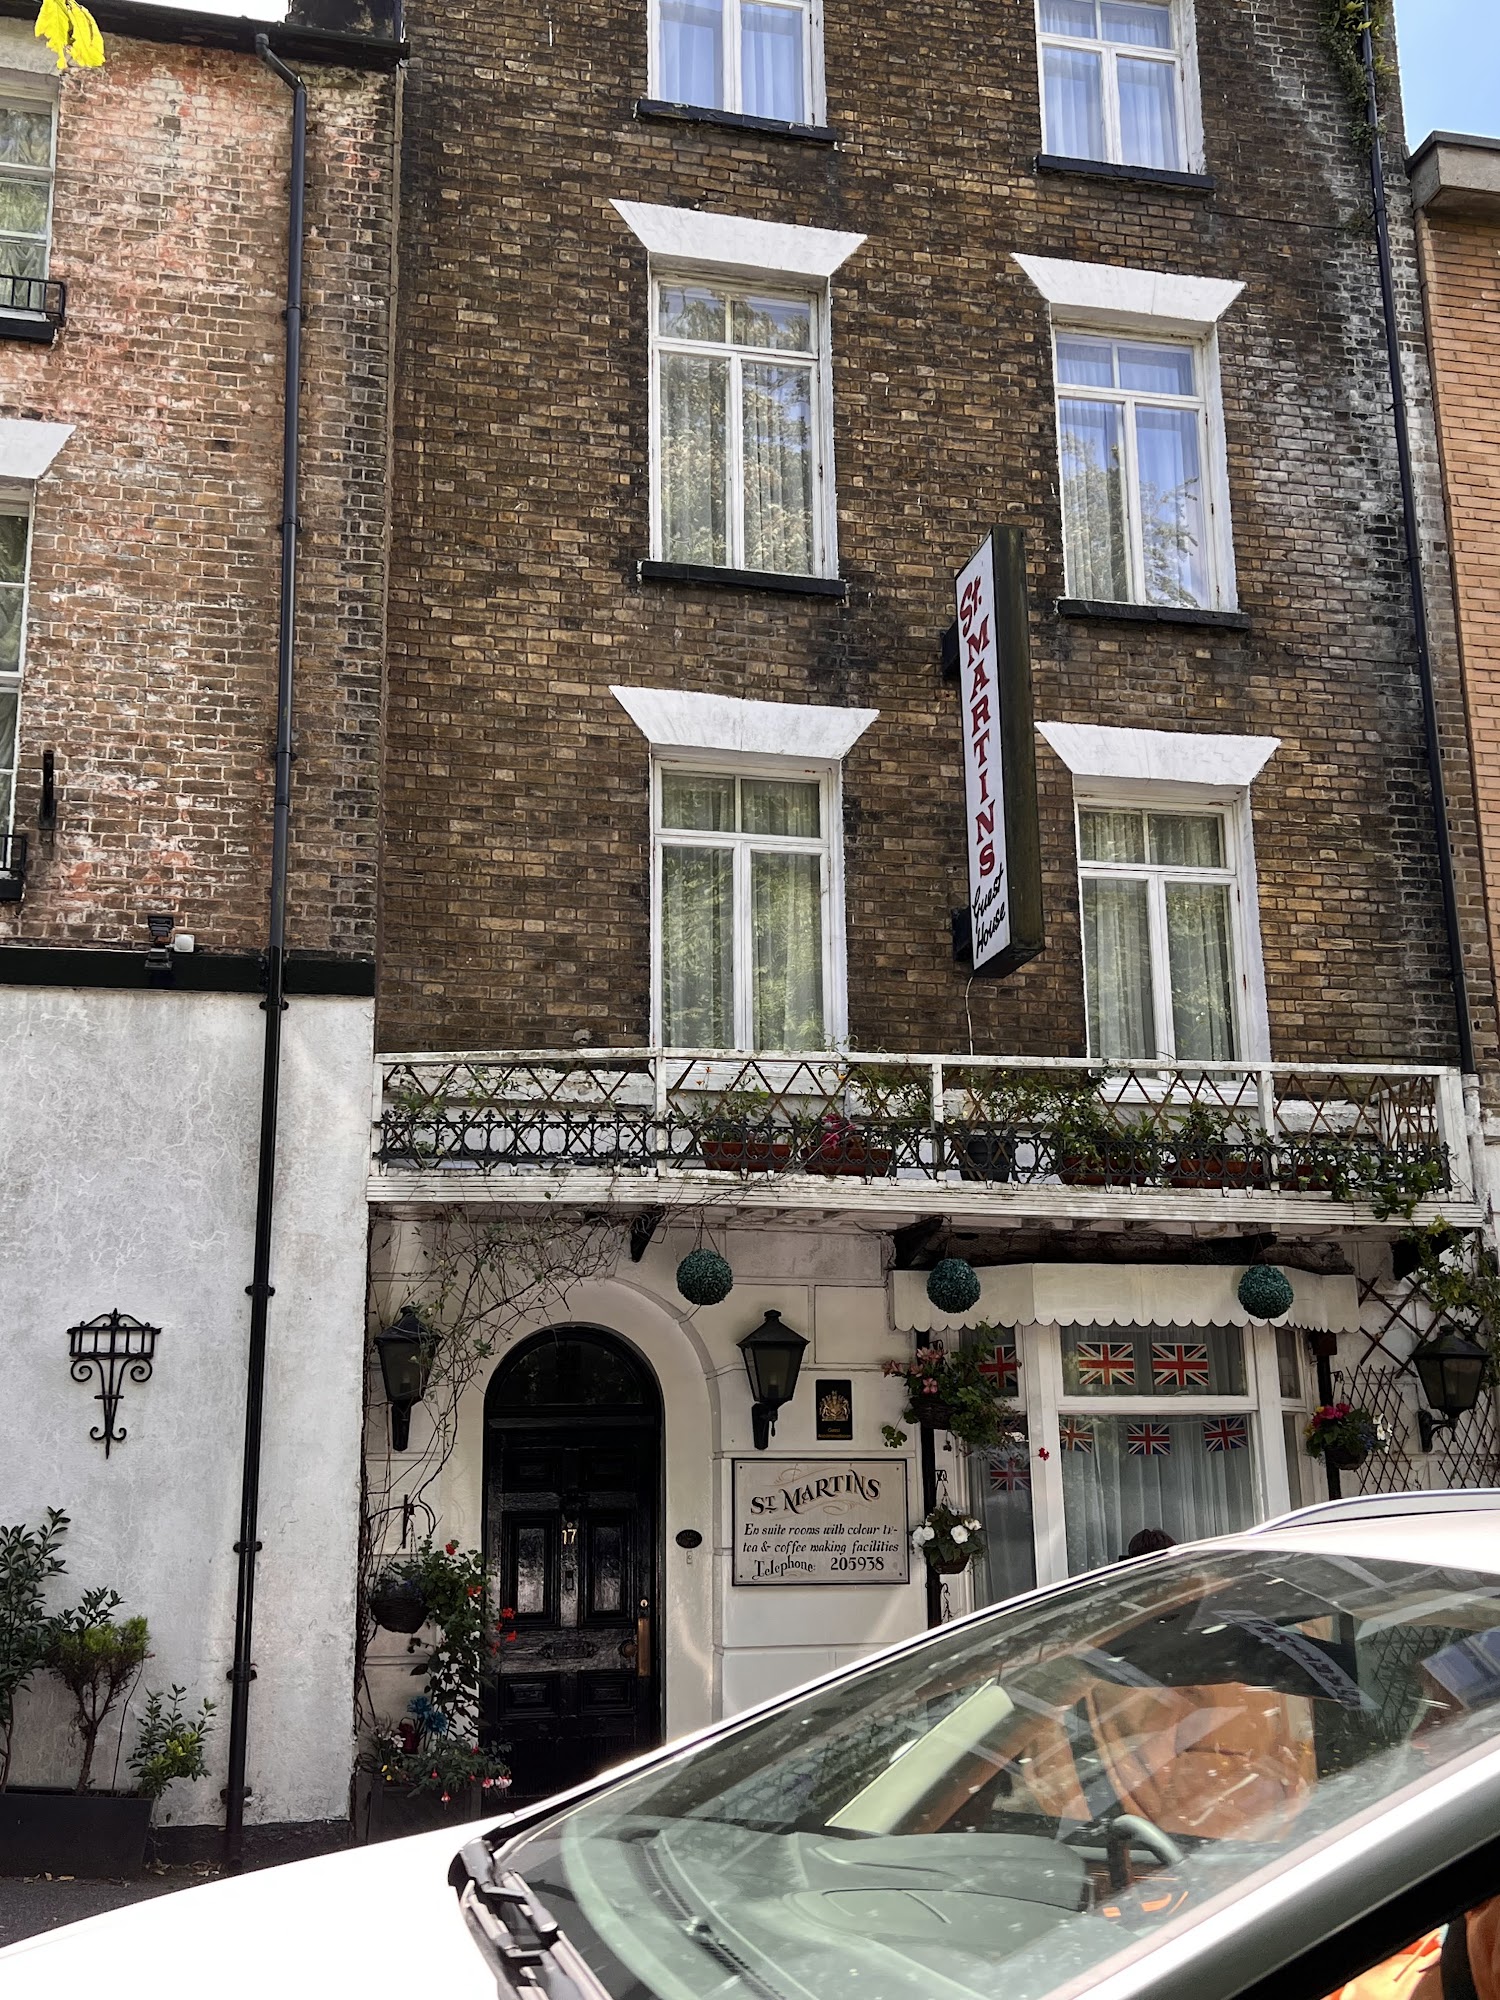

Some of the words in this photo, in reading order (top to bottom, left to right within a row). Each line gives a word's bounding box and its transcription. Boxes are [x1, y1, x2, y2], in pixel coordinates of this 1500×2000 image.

[959, 575, 982, 638] St.
[966, 613, 996, 879] MARTINS
[971, 862, 1004, 934] Guest
[975, 901, 1006, 960] House
[779, 1468, 881, 1515] MARTINS
[561, 1528, 578, 1545] 17
[742, 1542, 758, 1553] tea
[760, 1540, 772, 1553] &
[774, 1540, 807, 1555] coffee
[810, 1540, 847, 1556] making
[851, 1540, 899, 1555] facilities
[744, 1523, 760, 1536] En
[761, 1523, 786, 1535] suite
[788, 1526, 820, 1536] rooms
[823, 1523, 845, 1535] with
[847, 1523, 880, 1535] colour
[830, 1556, 885, 1572] 205938
